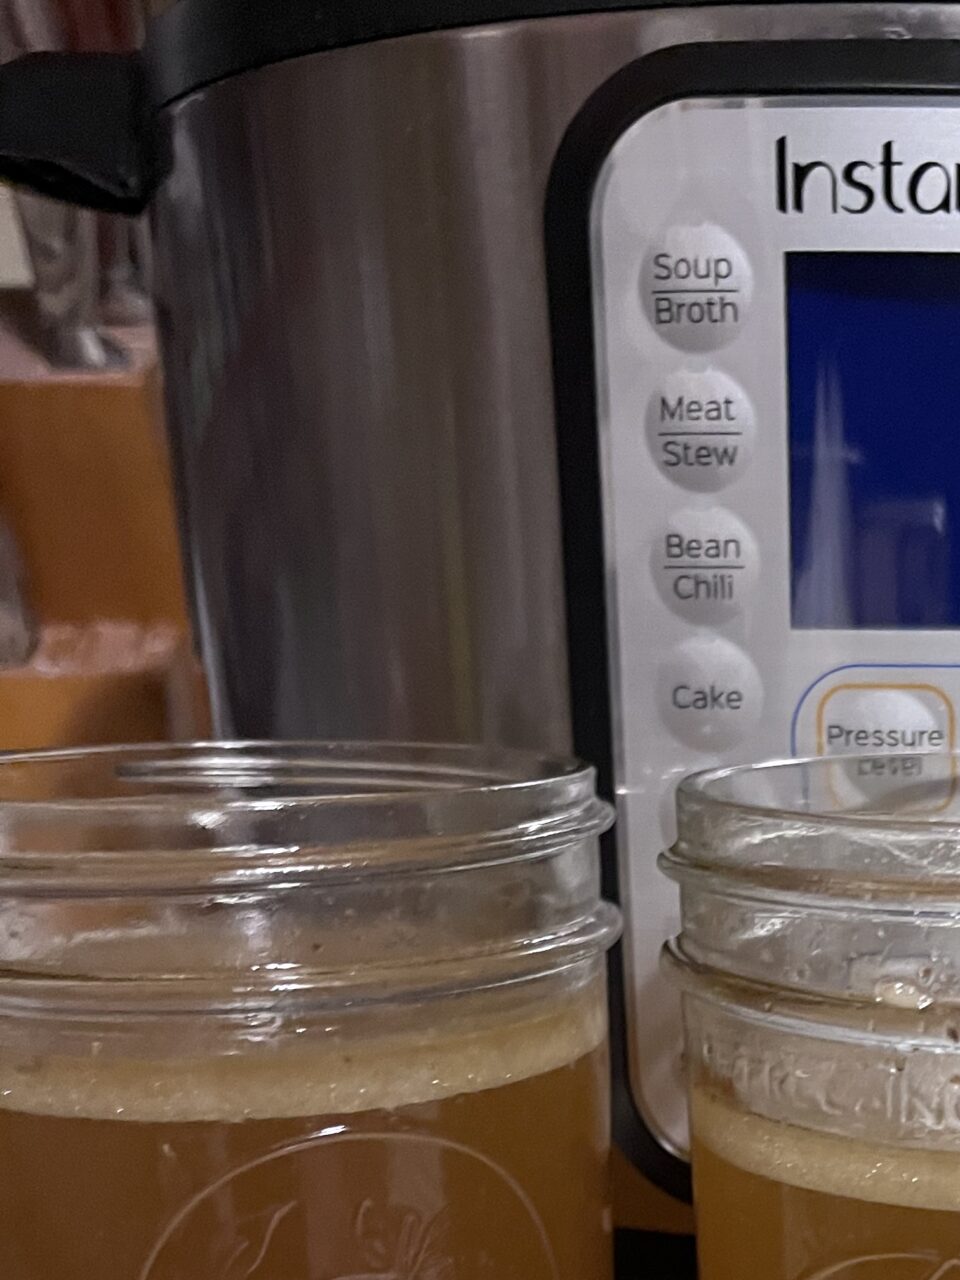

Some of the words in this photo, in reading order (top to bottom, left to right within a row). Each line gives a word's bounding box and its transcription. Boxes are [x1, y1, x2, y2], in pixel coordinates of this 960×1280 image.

[653, 253, 733, 286] Soup
[654, 297, 739, 325] Broth
[659, 397, 736, 423] Meat
[663, 442, 738, 468] Stew
[665, 535, 742, 561] Bean
[673, 574, 734, 601] Chili
[672, 685, 744, 711] Cake
[827, 725, 945, 748] Pressure
